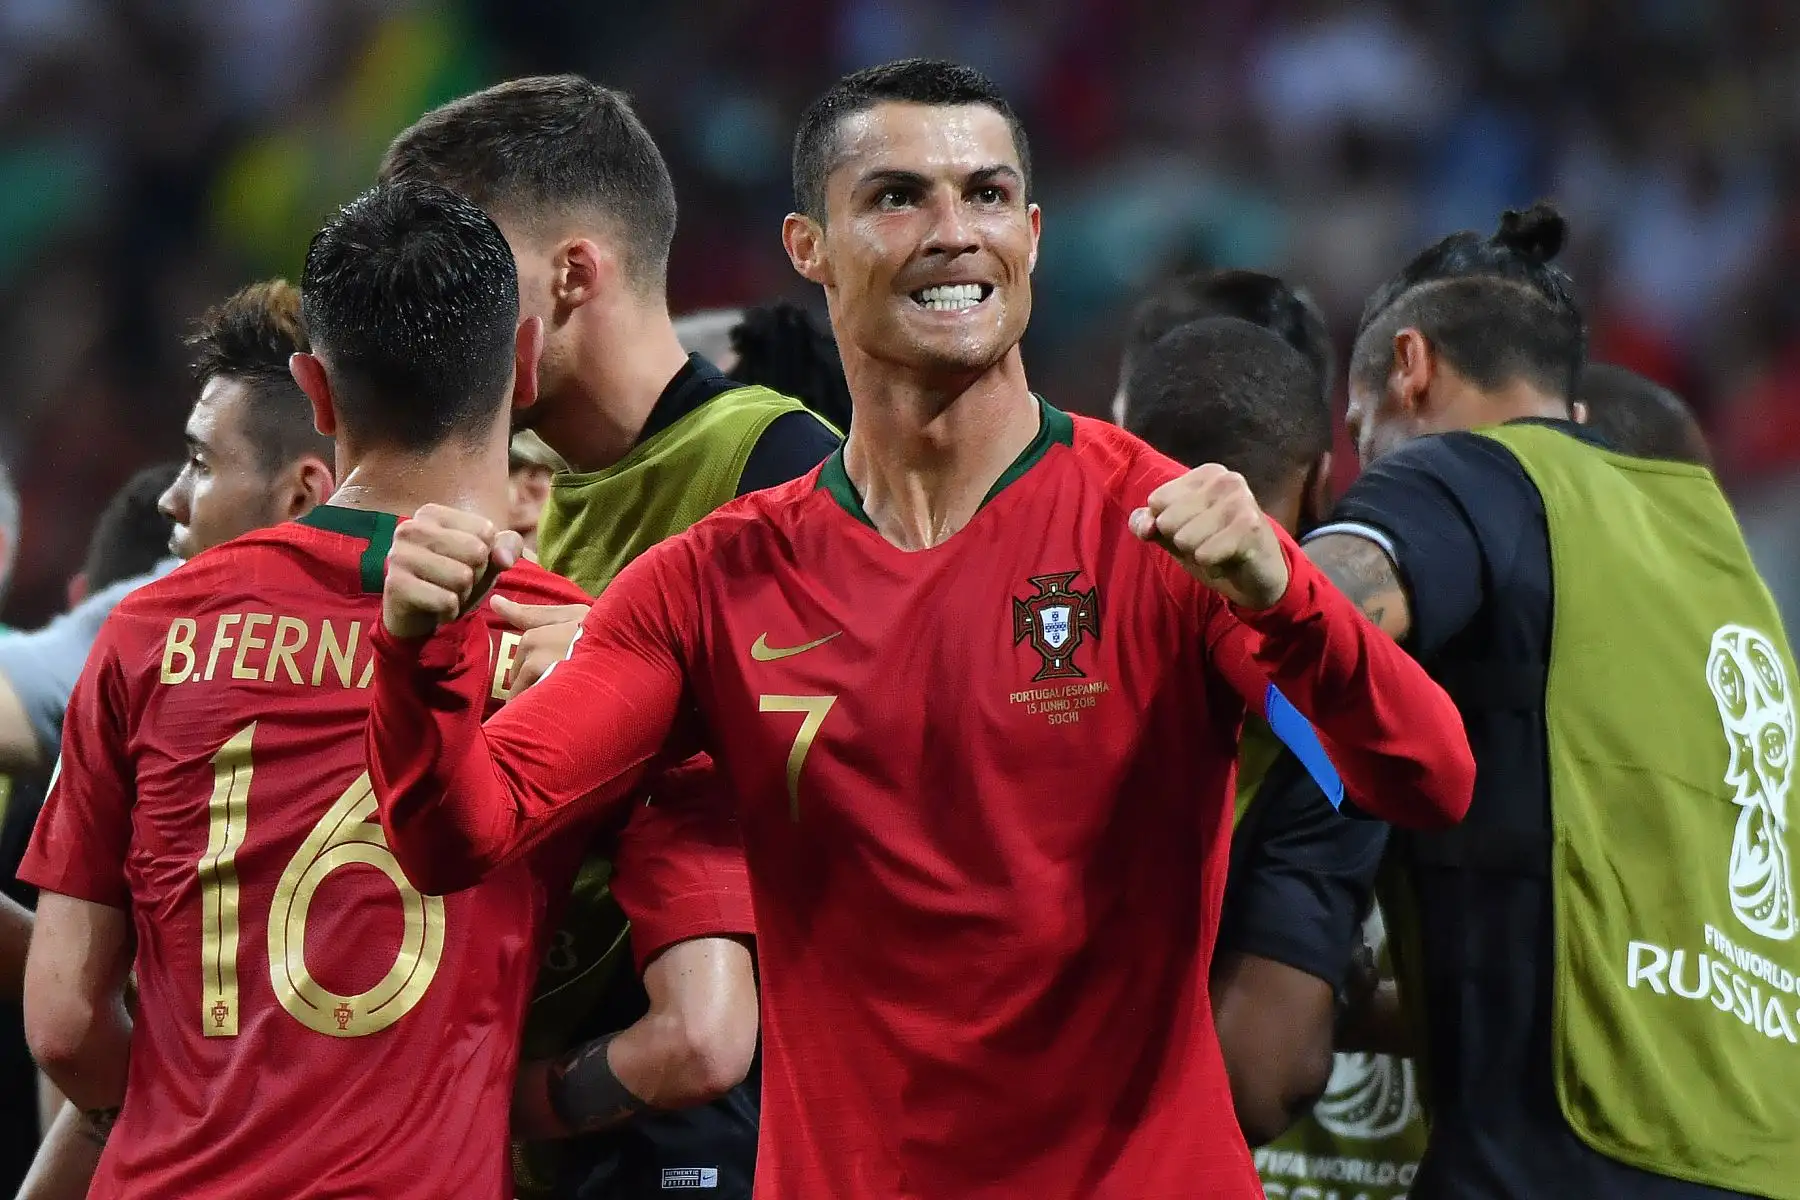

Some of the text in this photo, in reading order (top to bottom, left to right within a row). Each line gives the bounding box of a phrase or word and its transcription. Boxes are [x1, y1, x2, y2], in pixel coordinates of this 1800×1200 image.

[160, 612, 524, 701] B.FERNE
[1009, 681, 1109, 704] PORTUGAL/ESPANHA
[1026, 697, 1096, 714] 15 JUNHO 2018
[1048, 711, 1079, 725] SOCHI
[759, 694, 838, 822] 7
[198, 719, 446, 1038] 16
[1627, 940, 1798, 1044] RUSSIA
[1704, 923, 1735, 963] FIFA
[1733, 944, 1794, 993] WORLD
[1254, 1146, 1306, 1178] FIFA
